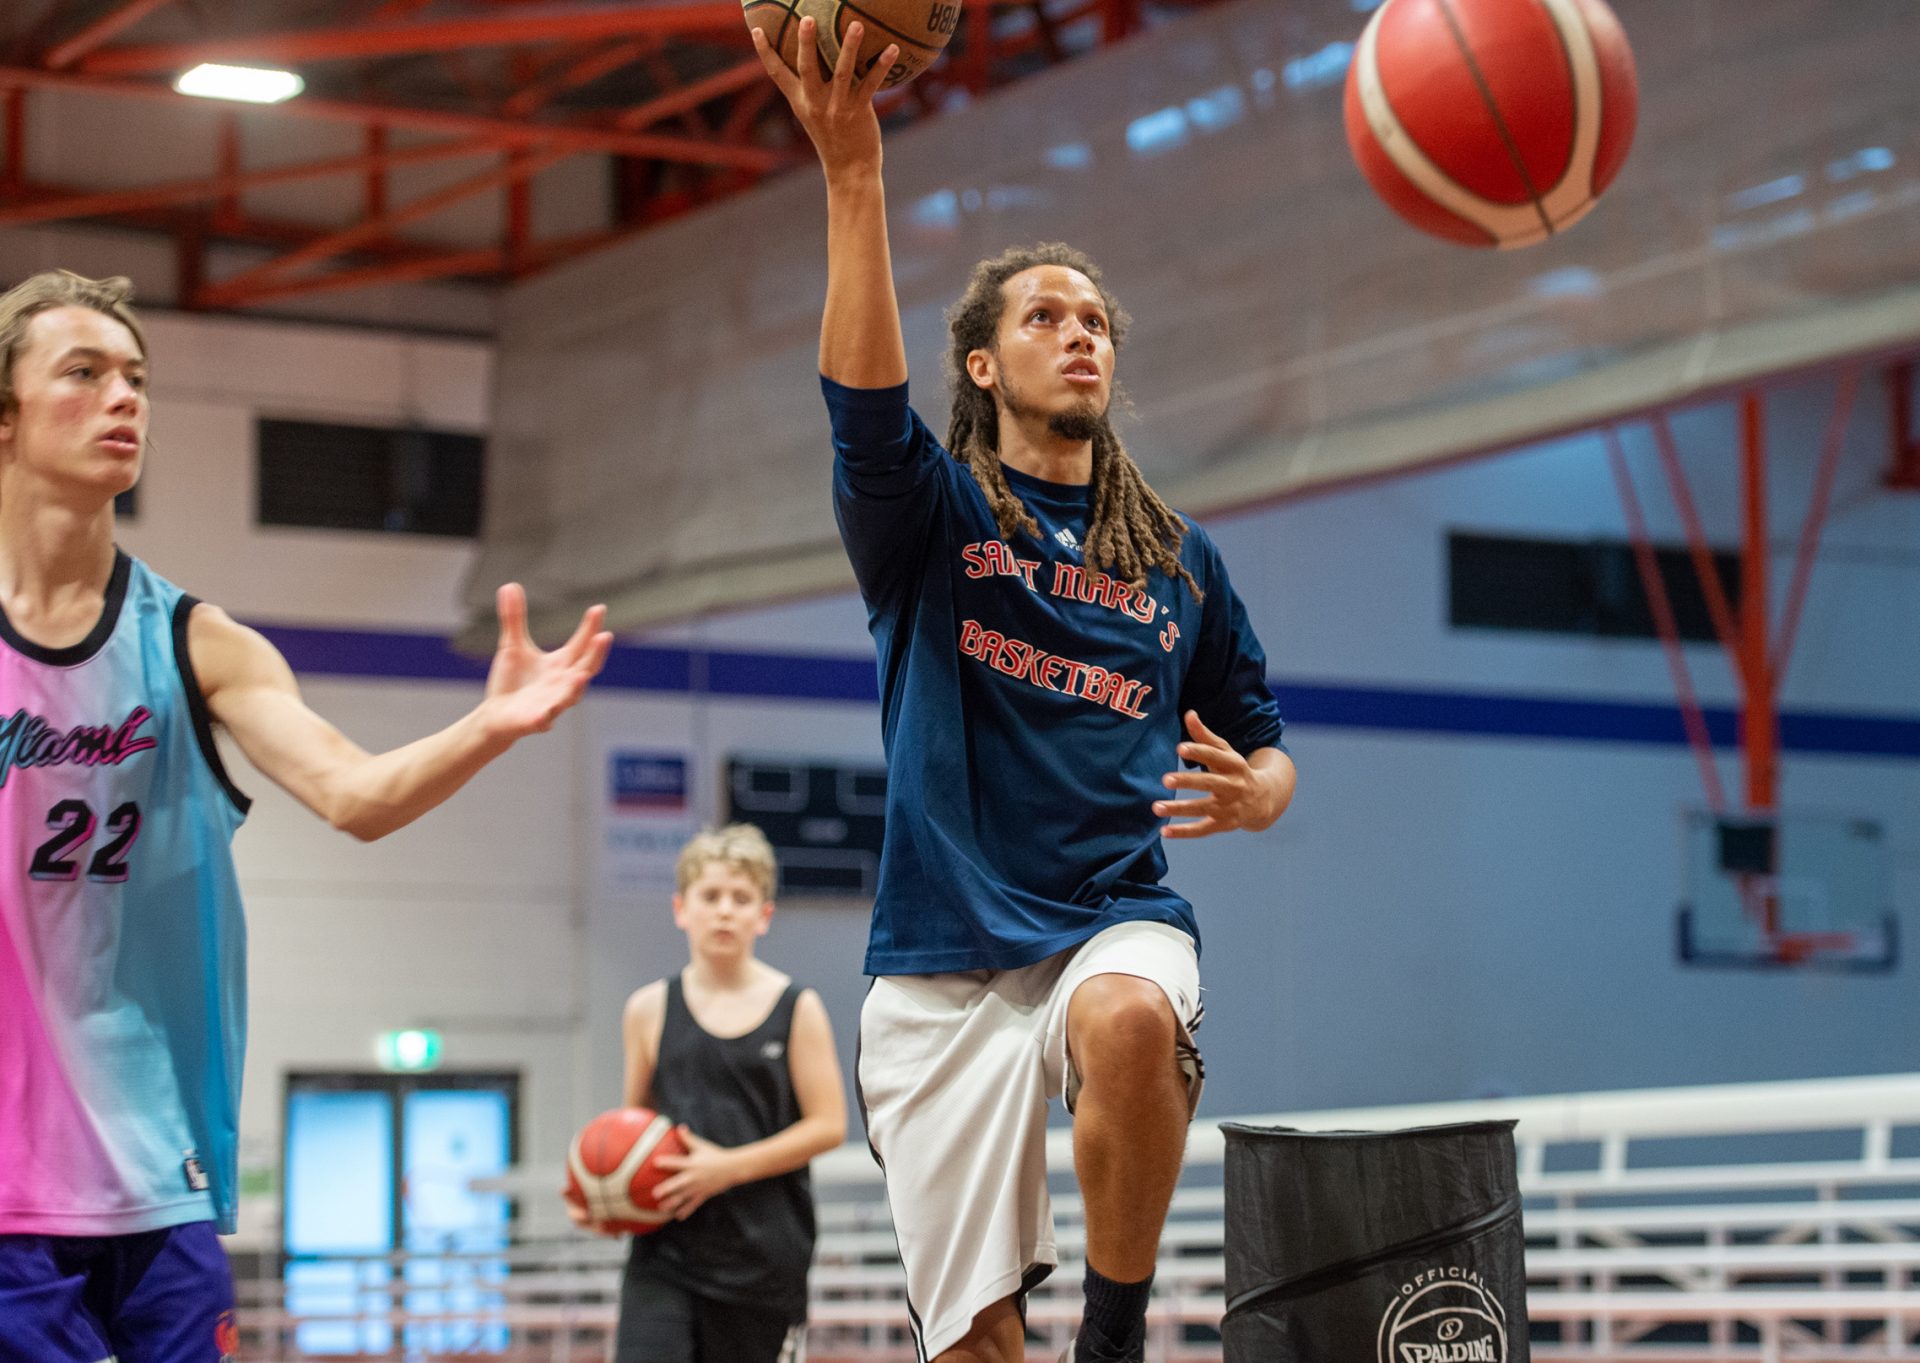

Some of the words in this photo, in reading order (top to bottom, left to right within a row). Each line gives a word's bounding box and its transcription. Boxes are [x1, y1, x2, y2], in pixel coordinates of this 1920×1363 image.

[961, 540, 1042, 593] SAIT
[1050, 560, 1180, 653] MARY'S
[958, 619, 1152, 720] BASKETBALL
[28, 799, 143, 883] 22
[1401, 1266, 1486, 1295] OFFICIAL
[1399, 1334, 1498, 1363] SPALDING
